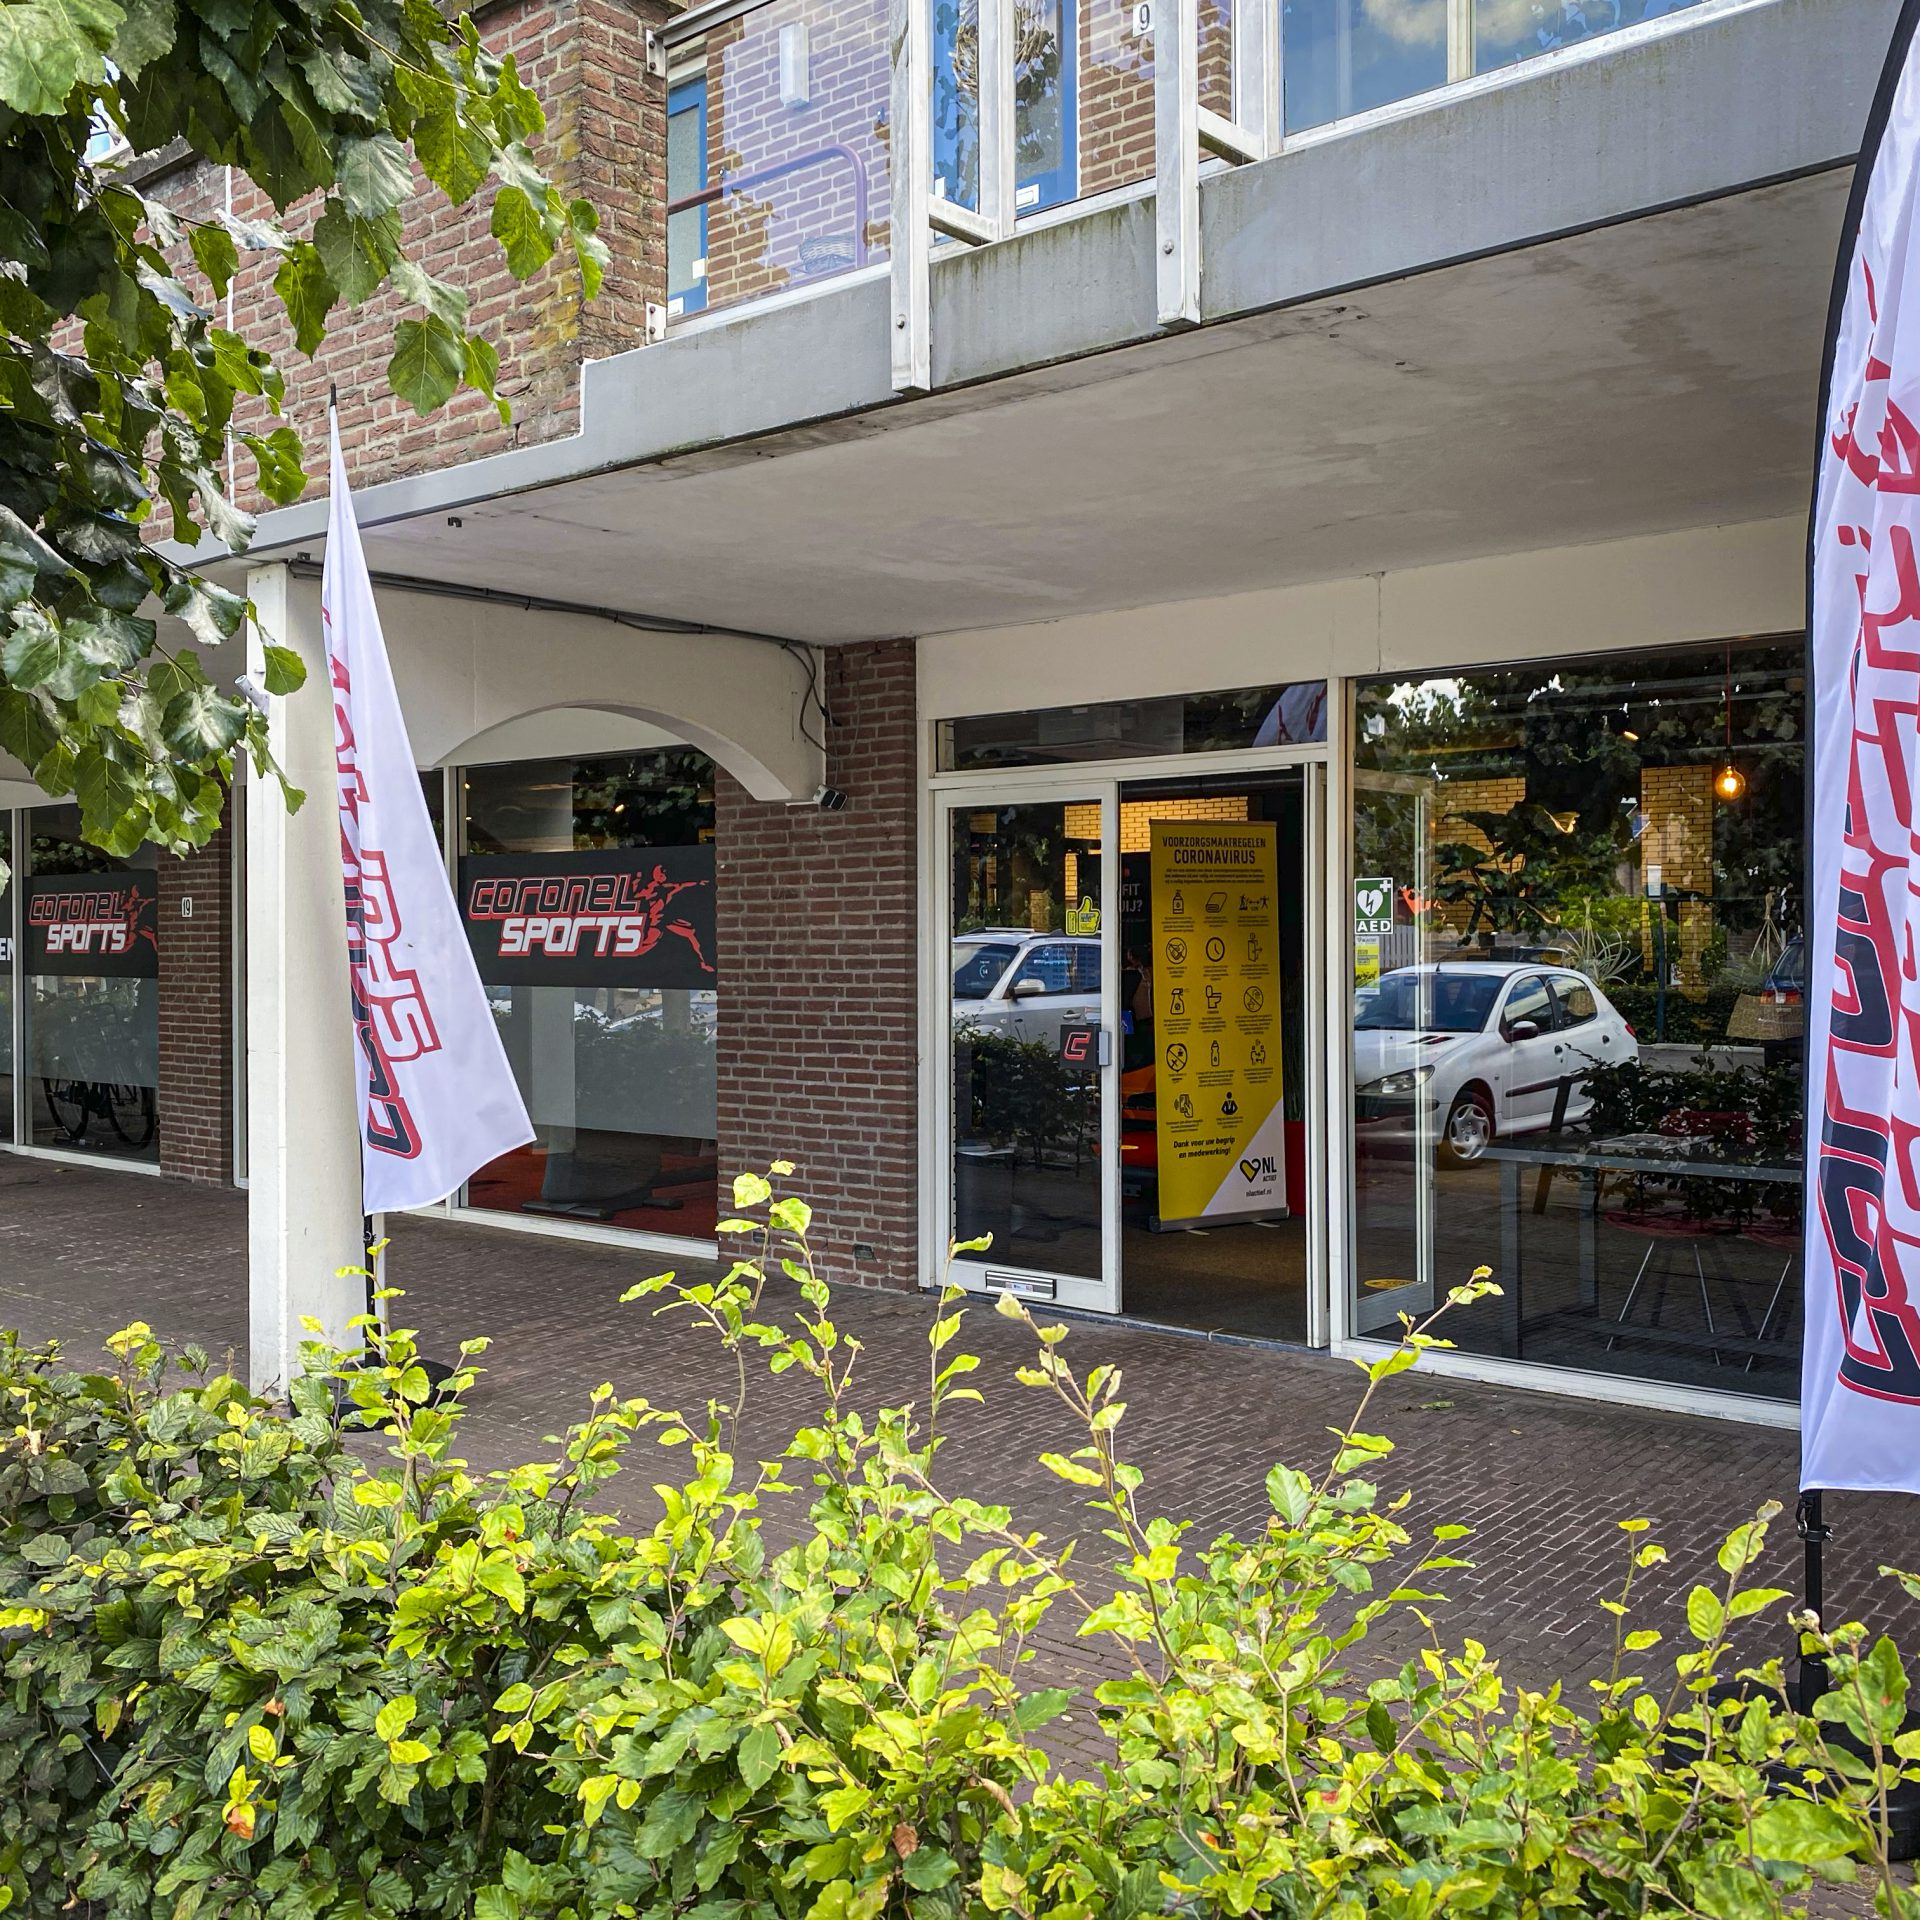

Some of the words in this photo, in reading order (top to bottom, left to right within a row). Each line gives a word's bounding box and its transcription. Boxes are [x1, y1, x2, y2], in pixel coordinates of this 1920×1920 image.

[1139, 3, 1150, 31] 9
[1162, 836, 1266, 848] VOORZORGSMAATREGELEN
[1174, 849, 1256, 864] CORONAVIRUS
[182, 899, 192, 916] 19
[1357, 920, 1391, 932] AED
[1173, 1138, 1190, 1149] Dank
[1190, 1139, 1204, 1147] voor
[1205, 1138, 1215, 1146] uw
[1215, 1136, 1236, 1146] begrip
[1178, 1151, 1187, 1159] en
[1187, 1147, 1231, 1158] medewerking!
[1262, 1156, 1277, 1174] NL
